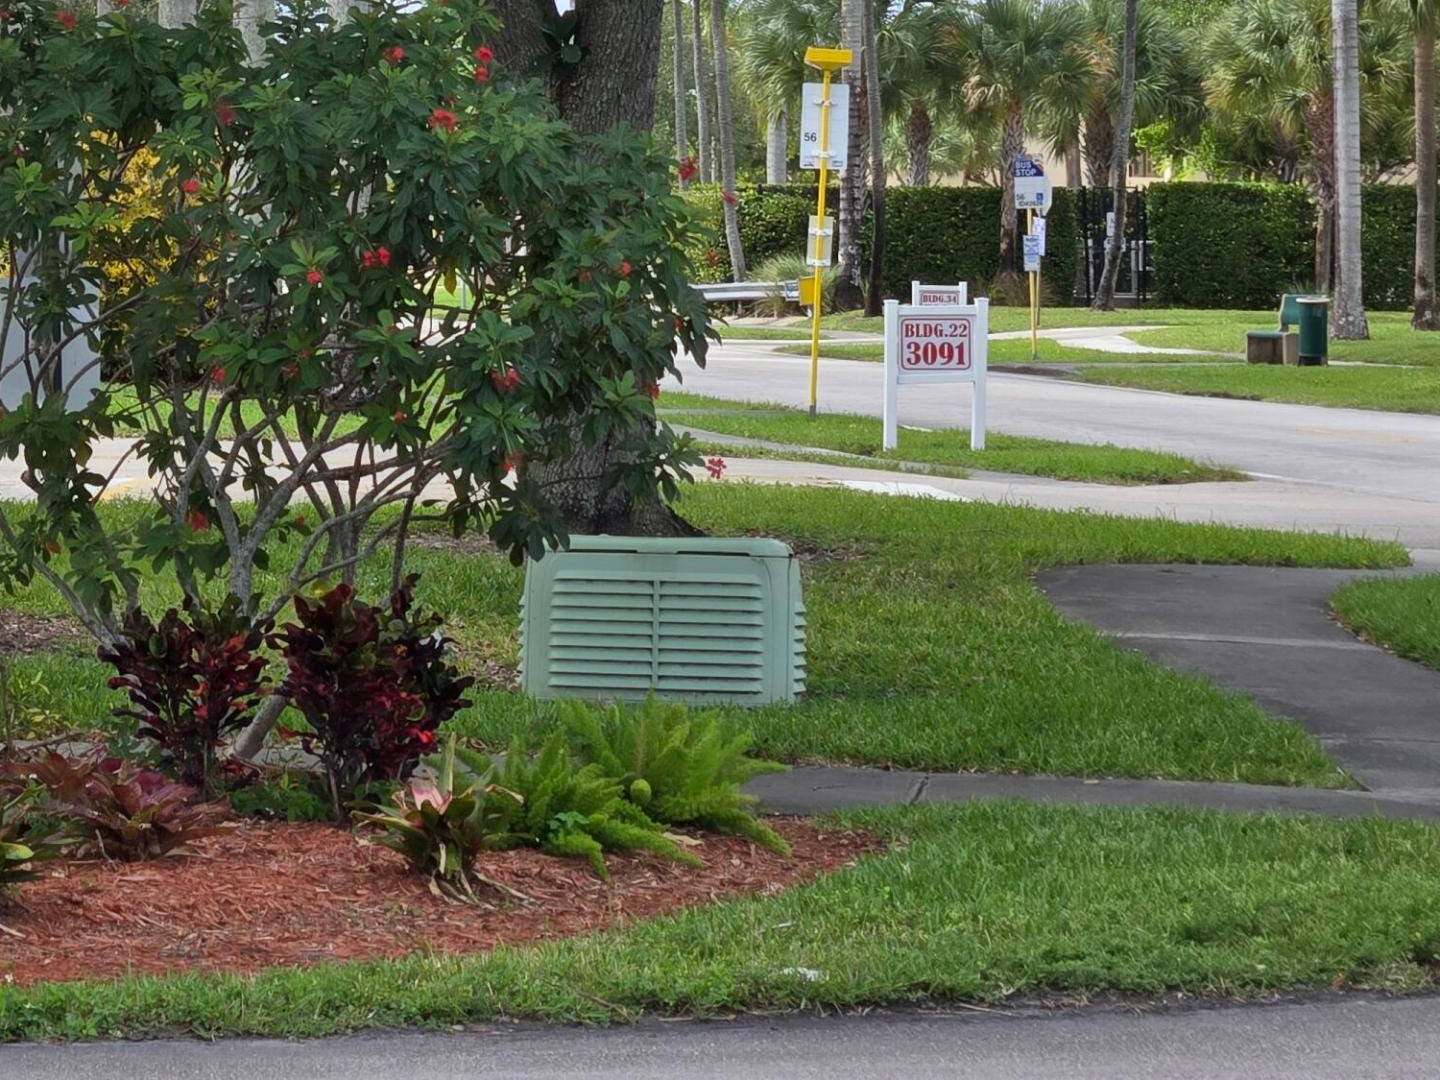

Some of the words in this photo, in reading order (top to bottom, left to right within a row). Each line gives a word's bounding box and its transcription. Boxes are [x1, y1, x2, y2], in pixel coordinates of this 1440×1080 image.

[803, 131, 817, 142] 56
[1015, 168, 1037, 176] STOP
[904, 323, 968, 338] BLDG.22
[906, 341, 966, 366] 3091
